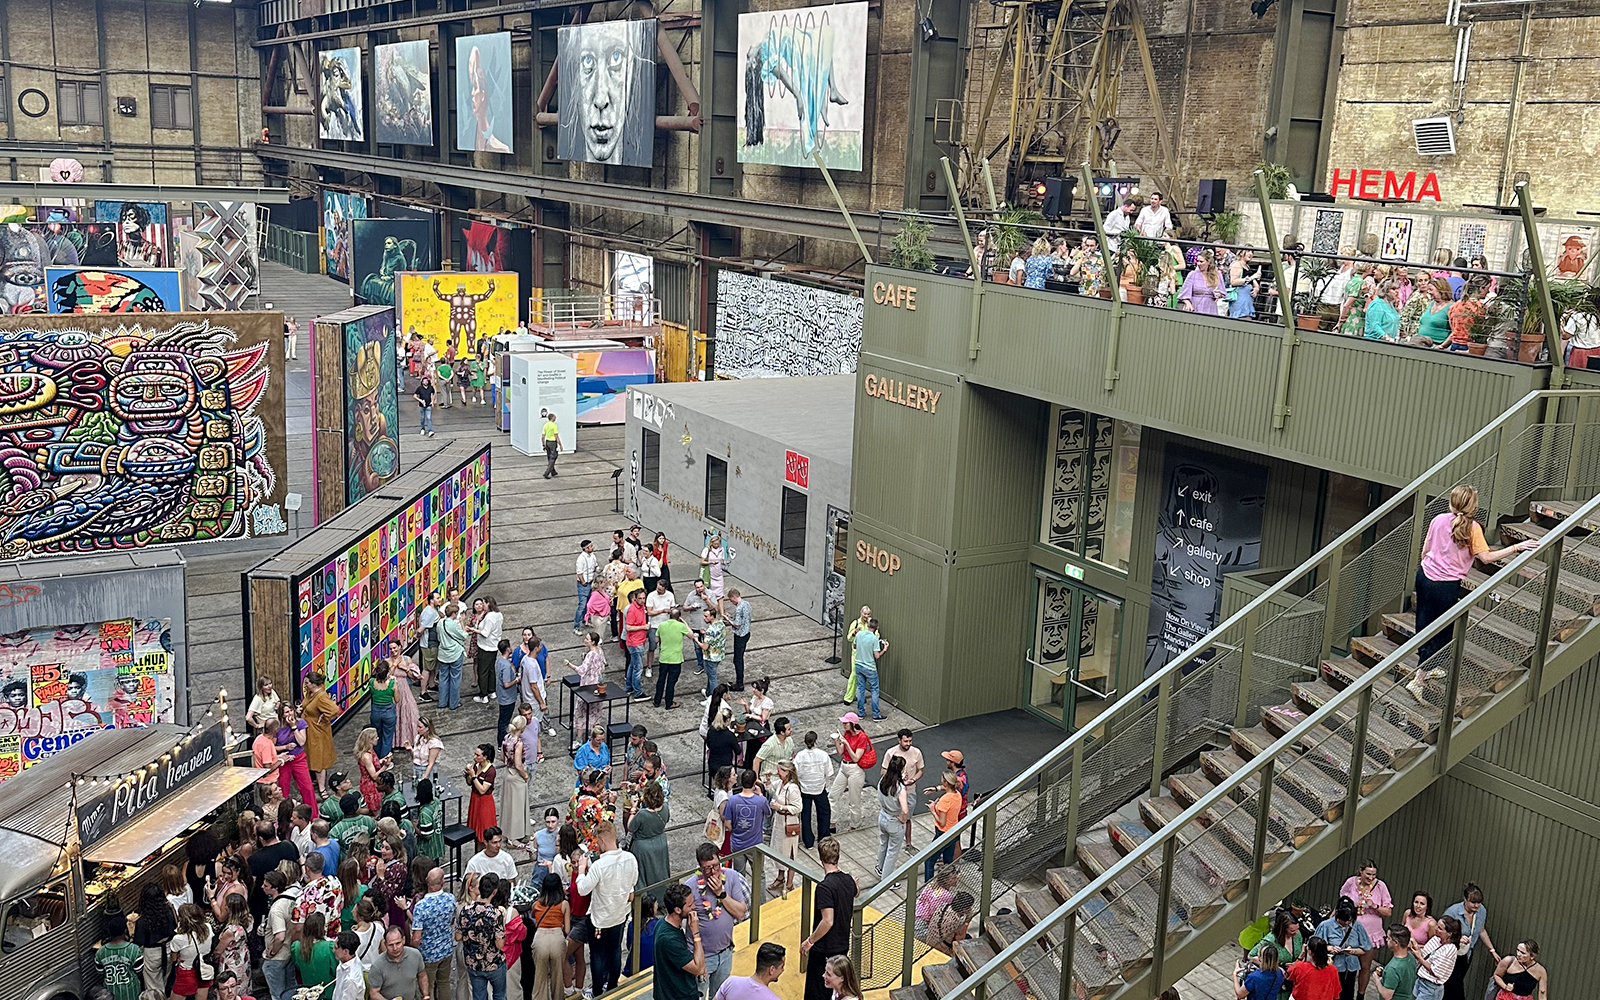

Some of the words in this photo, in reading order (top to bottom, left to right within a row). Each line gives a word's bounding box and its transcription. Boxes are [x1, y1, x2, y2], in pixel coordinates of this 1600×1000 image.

[1331, 168, 1442, 202] HEMA
[873, 281, 917, 311] CAFE
[864, 374, 941, 414] GALLERY
[1192, 488, 1212, 503] exit
[1189, 516, 1213, 532] cafe
[856, 540, 901, 576] SHOP
[1187, 543, 1222, 565] gallery
[1184, 569, 1211, 588] shop
[1165, 611, 1180, 623] Now
[1180, 617, 1190, 627] On
[1190, 621, 1207, 633] View
[1165, 621, 1177, 632] The
[1177, 628, 1199, 642] Gallery
[111, 775, 159, 826] Pita
[165, 744, 213, 790] heaven
[104, 963, 130, 985] 32
